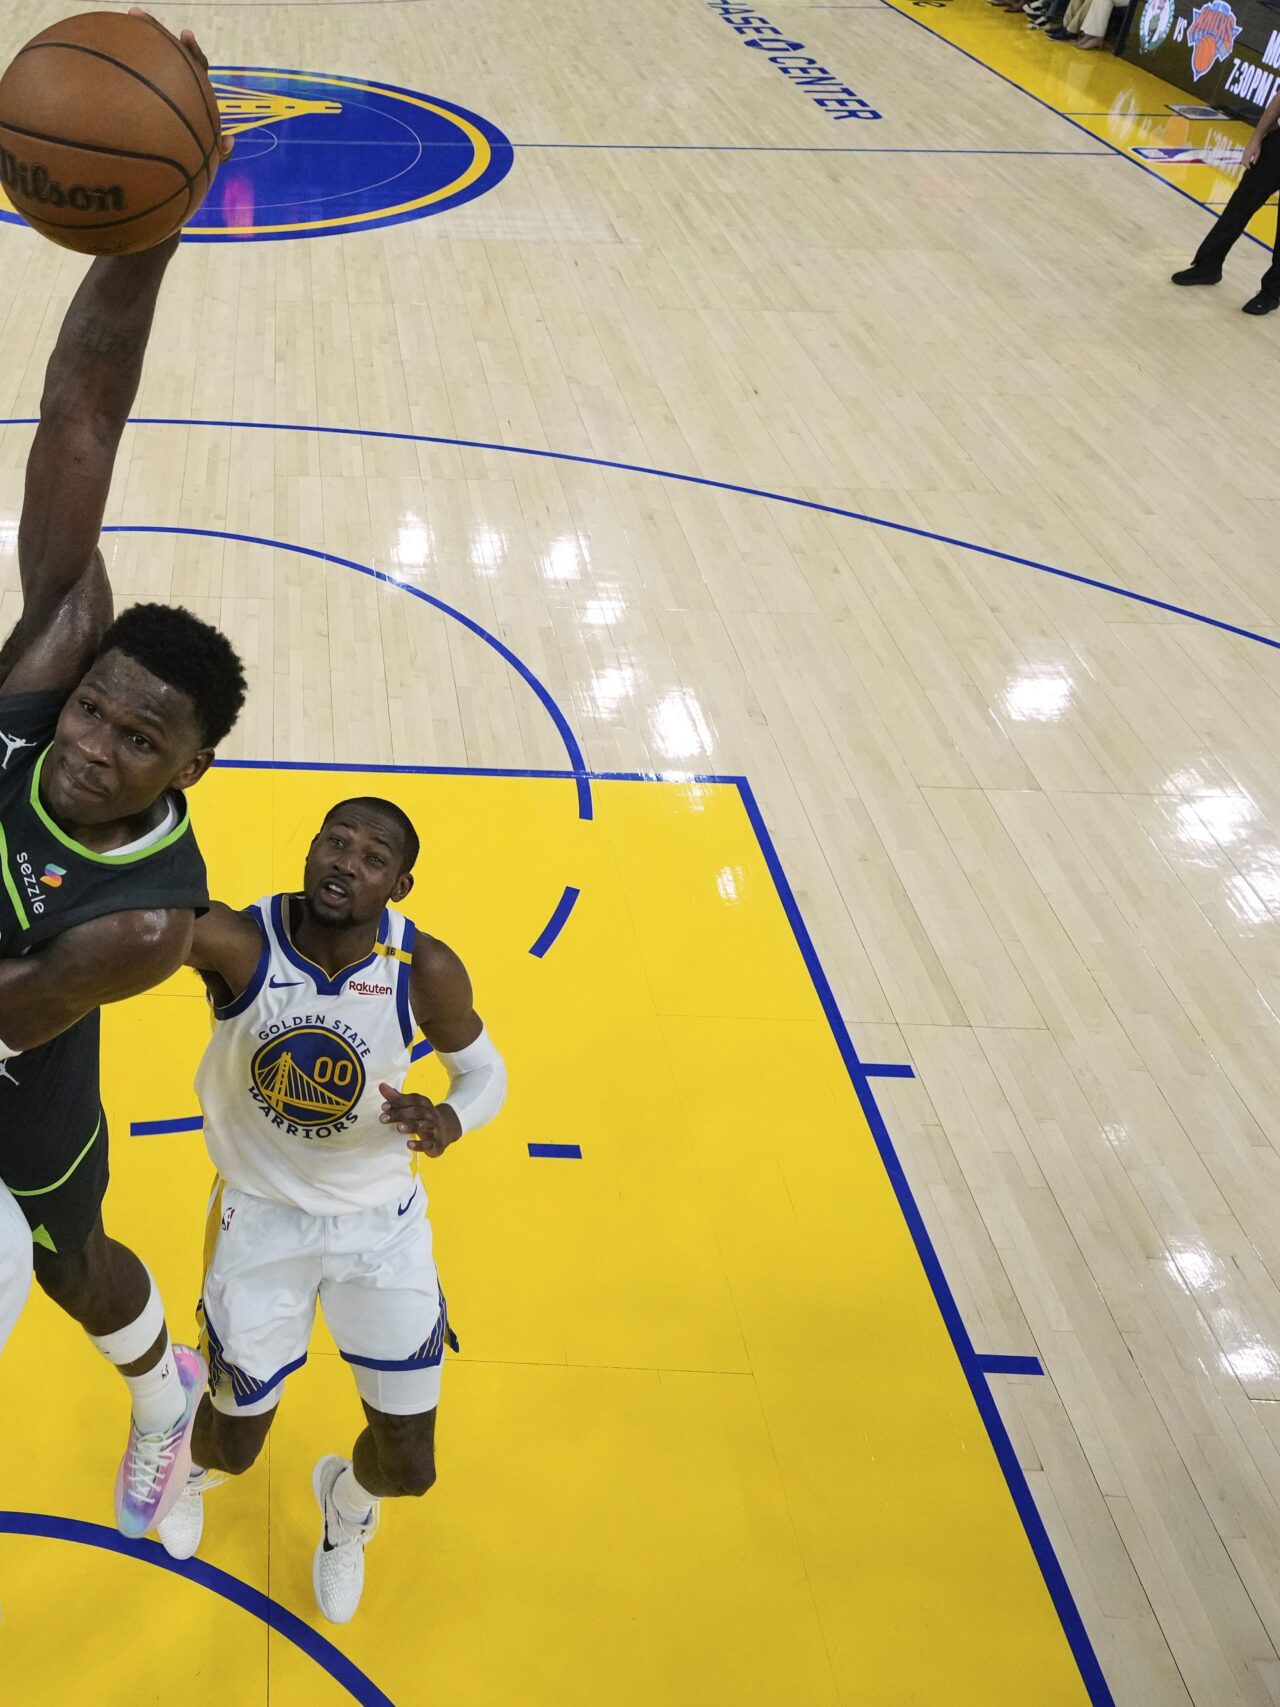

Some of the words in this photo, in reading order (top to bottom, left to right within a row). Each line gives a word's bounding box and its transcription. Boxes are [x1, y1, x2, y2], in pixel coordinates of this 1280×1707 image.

[768, 56, 883, 120] CENTER
[1224, 58, 1274, 107] 7:30PM
[17, 851, 45, 914] sezzle
[349, 980, 392, 995] Rakuten
[258, 1014, 326, 1041] GOLDEN
[332, 1020, 371, 1058] STATE
[313, 1056, 353, 1086] 00
[248, 1084, 358, 1140] WARRIORS
